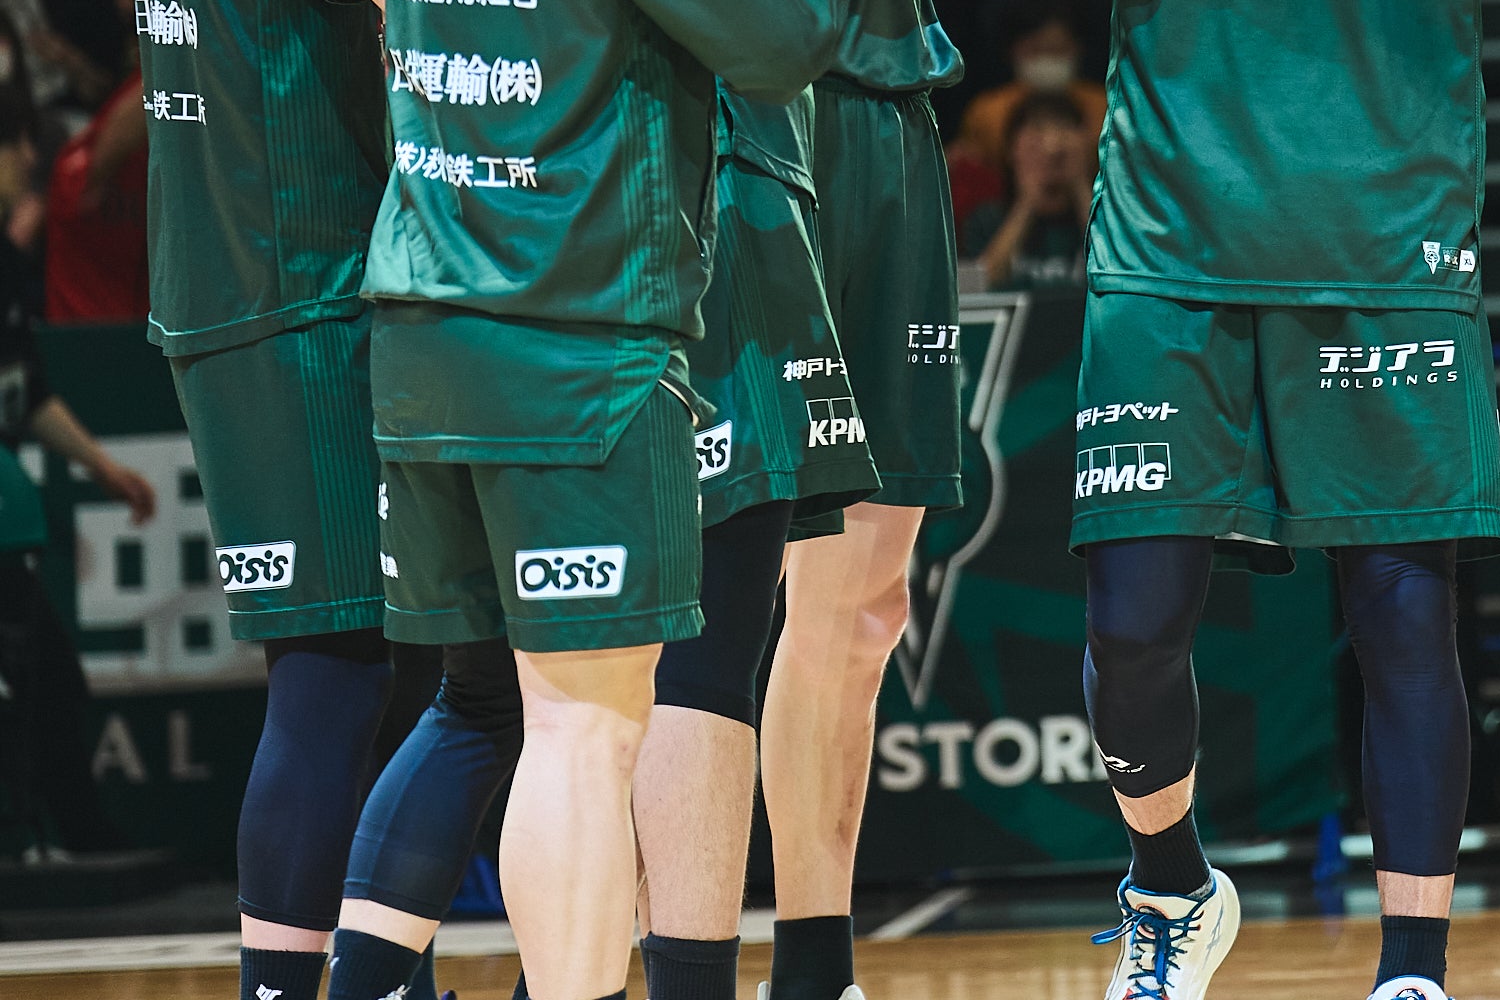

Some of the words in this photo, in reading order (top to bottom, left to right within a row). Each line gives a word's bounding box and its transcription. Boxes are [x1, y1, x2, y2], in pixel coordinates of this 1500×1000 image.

[1320, 340, 1455, 373] デジアラ
[1320, 370, 1458, 389] HOLDINGS
[1075, 462, 1168, 500] KPMG
[218, 549, 289, 586] Oisis
[520, 554, 617, 592] Oisis
[876, 715, 1108, 790] STOR
